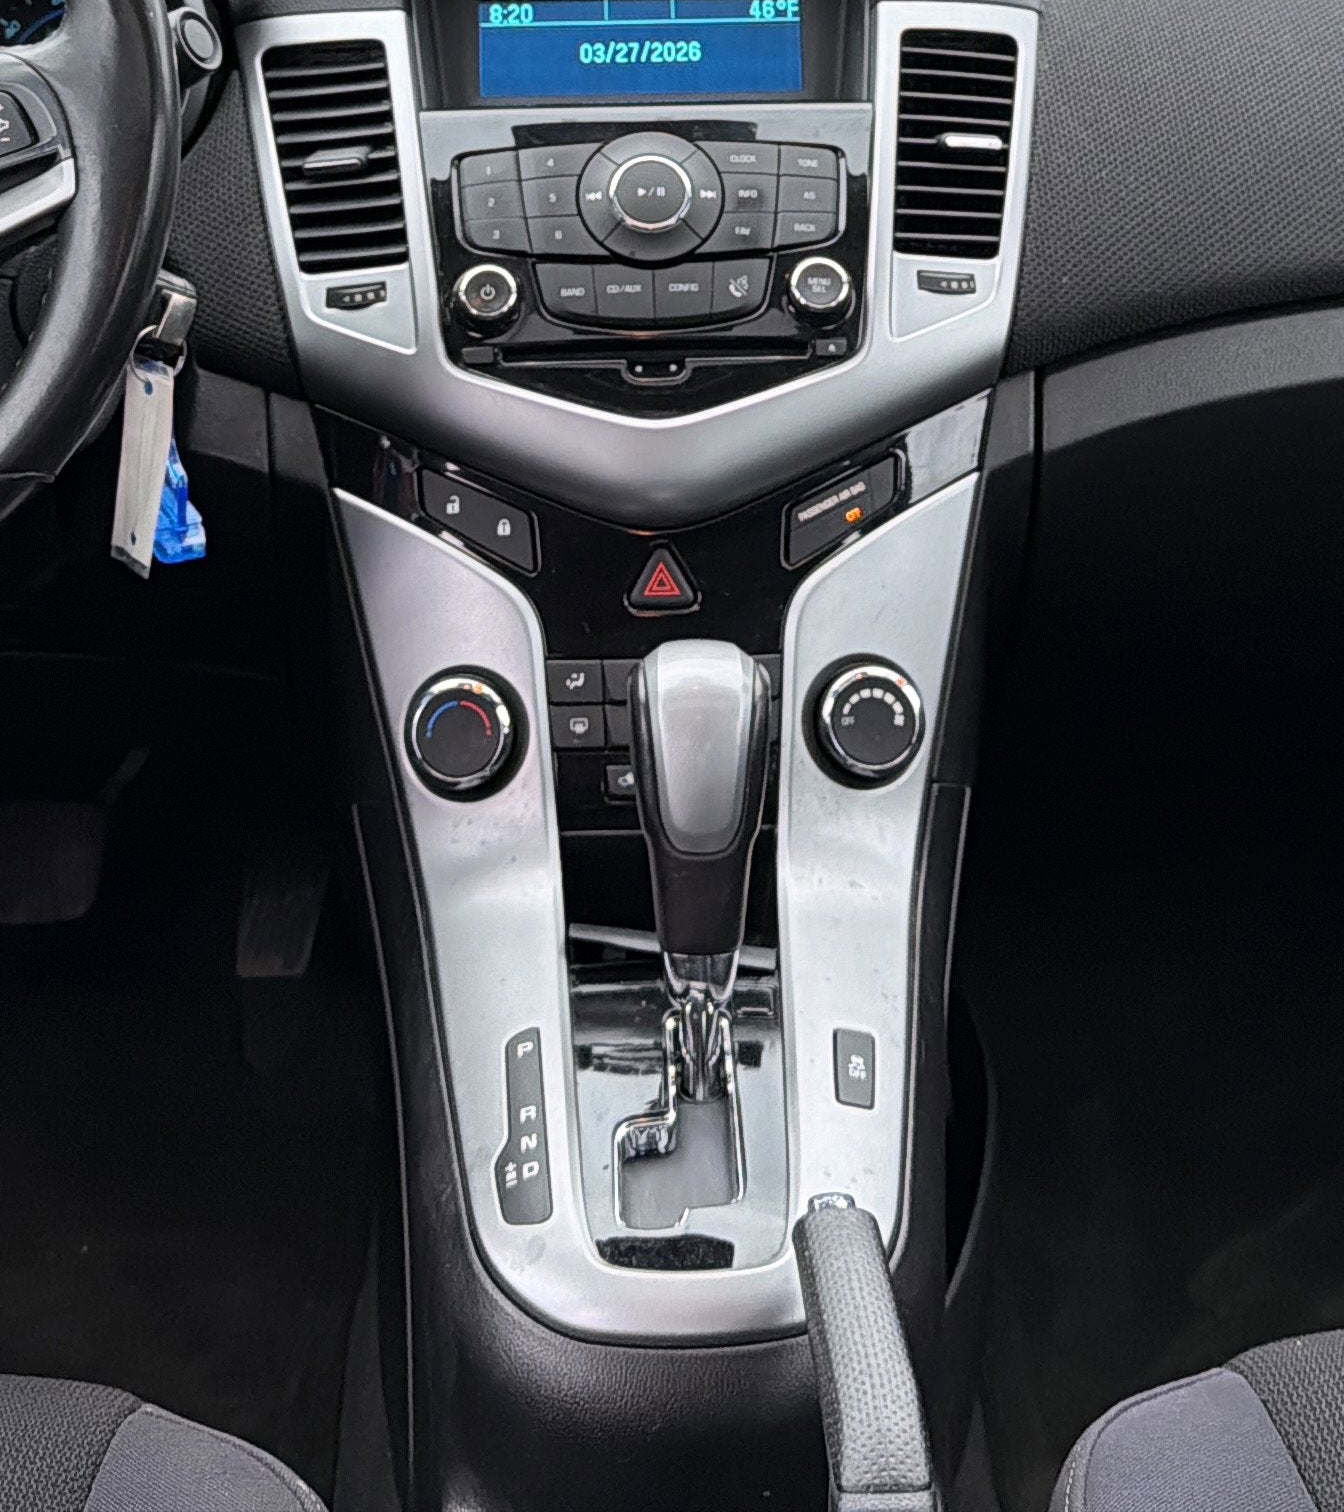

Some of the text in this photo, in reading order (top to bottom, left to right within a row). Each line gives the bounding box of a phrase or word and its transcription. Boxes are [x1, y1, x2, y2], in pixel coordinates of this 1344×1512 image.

[488, 2, 534, 25] 8:20
[579, 40, 702, 65] 03/27/2026
[546, 157, 554, 167] 4
[668, 282, 700, 292] CONFIG
[807, 276, 832, 286] MENU
[560, 287, 586, 297] BAND
[516, 1040, 534, 1058] P
[519, 1104, 537, 1124] R
[520, 1132, 538, 1154] N
[522, 1160, 540, 1181] D
